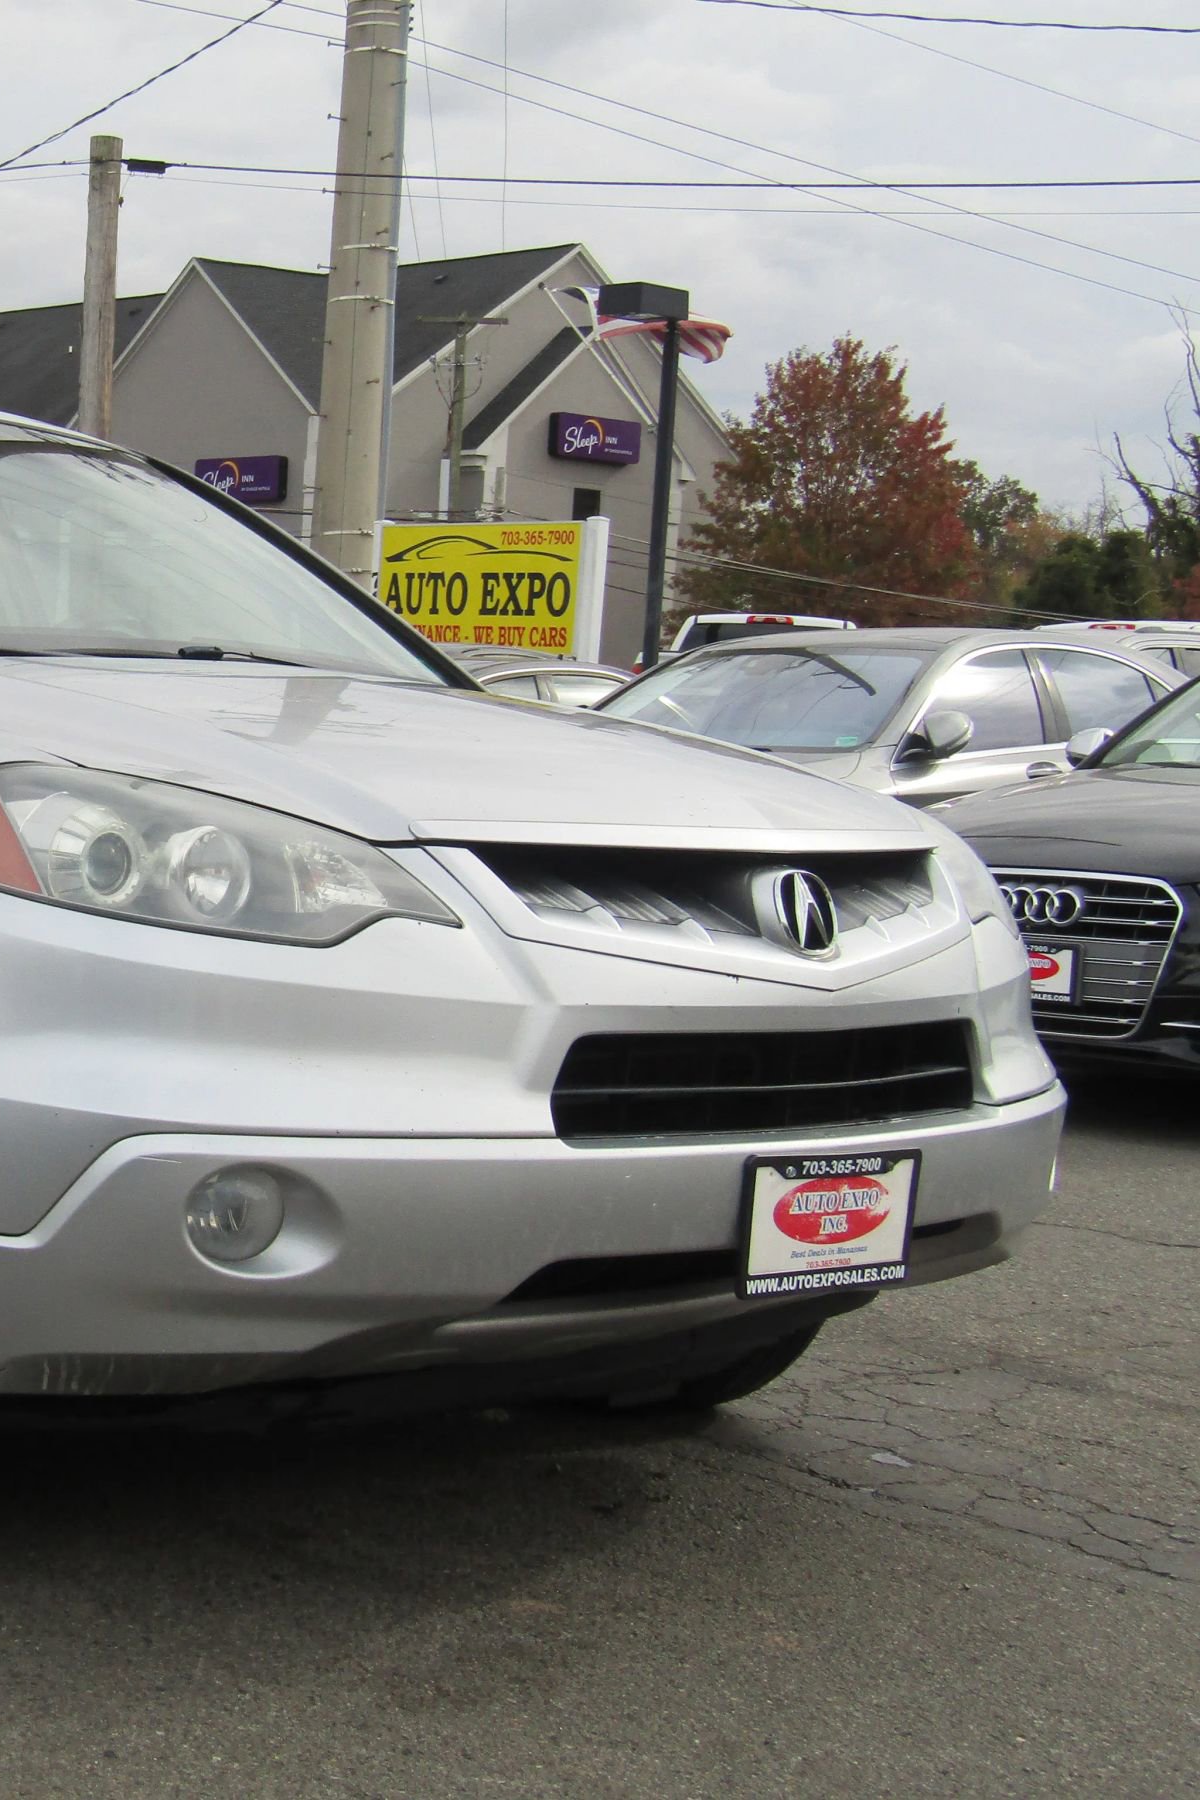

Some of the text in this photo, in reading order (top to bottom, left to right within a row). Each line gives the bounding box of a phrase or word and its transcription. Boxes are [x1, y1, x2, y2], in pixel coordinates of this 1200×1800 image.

[563, 426, 599, 454] Sleep
[605, 436, 618, 445] INN
[501, 530, 575, 545] 703-365-7900
[385, 571, 571, 618] AUTO EXPO
[412, 624, 461, 642] NANCE
[473, 625, 493, 645] WE
[498, 626, 525, 647] BUY
[529, 626, 567, 648] CARS
[802, 1157, 882, 1175] 703-365-7900
[789, 1188, 880, 1214] AUTO EXPO
[820, 1215, 848, 1235] INC.
[746, 1264, 905, 1295] WWW.AUTOEXPOSALES.COM
